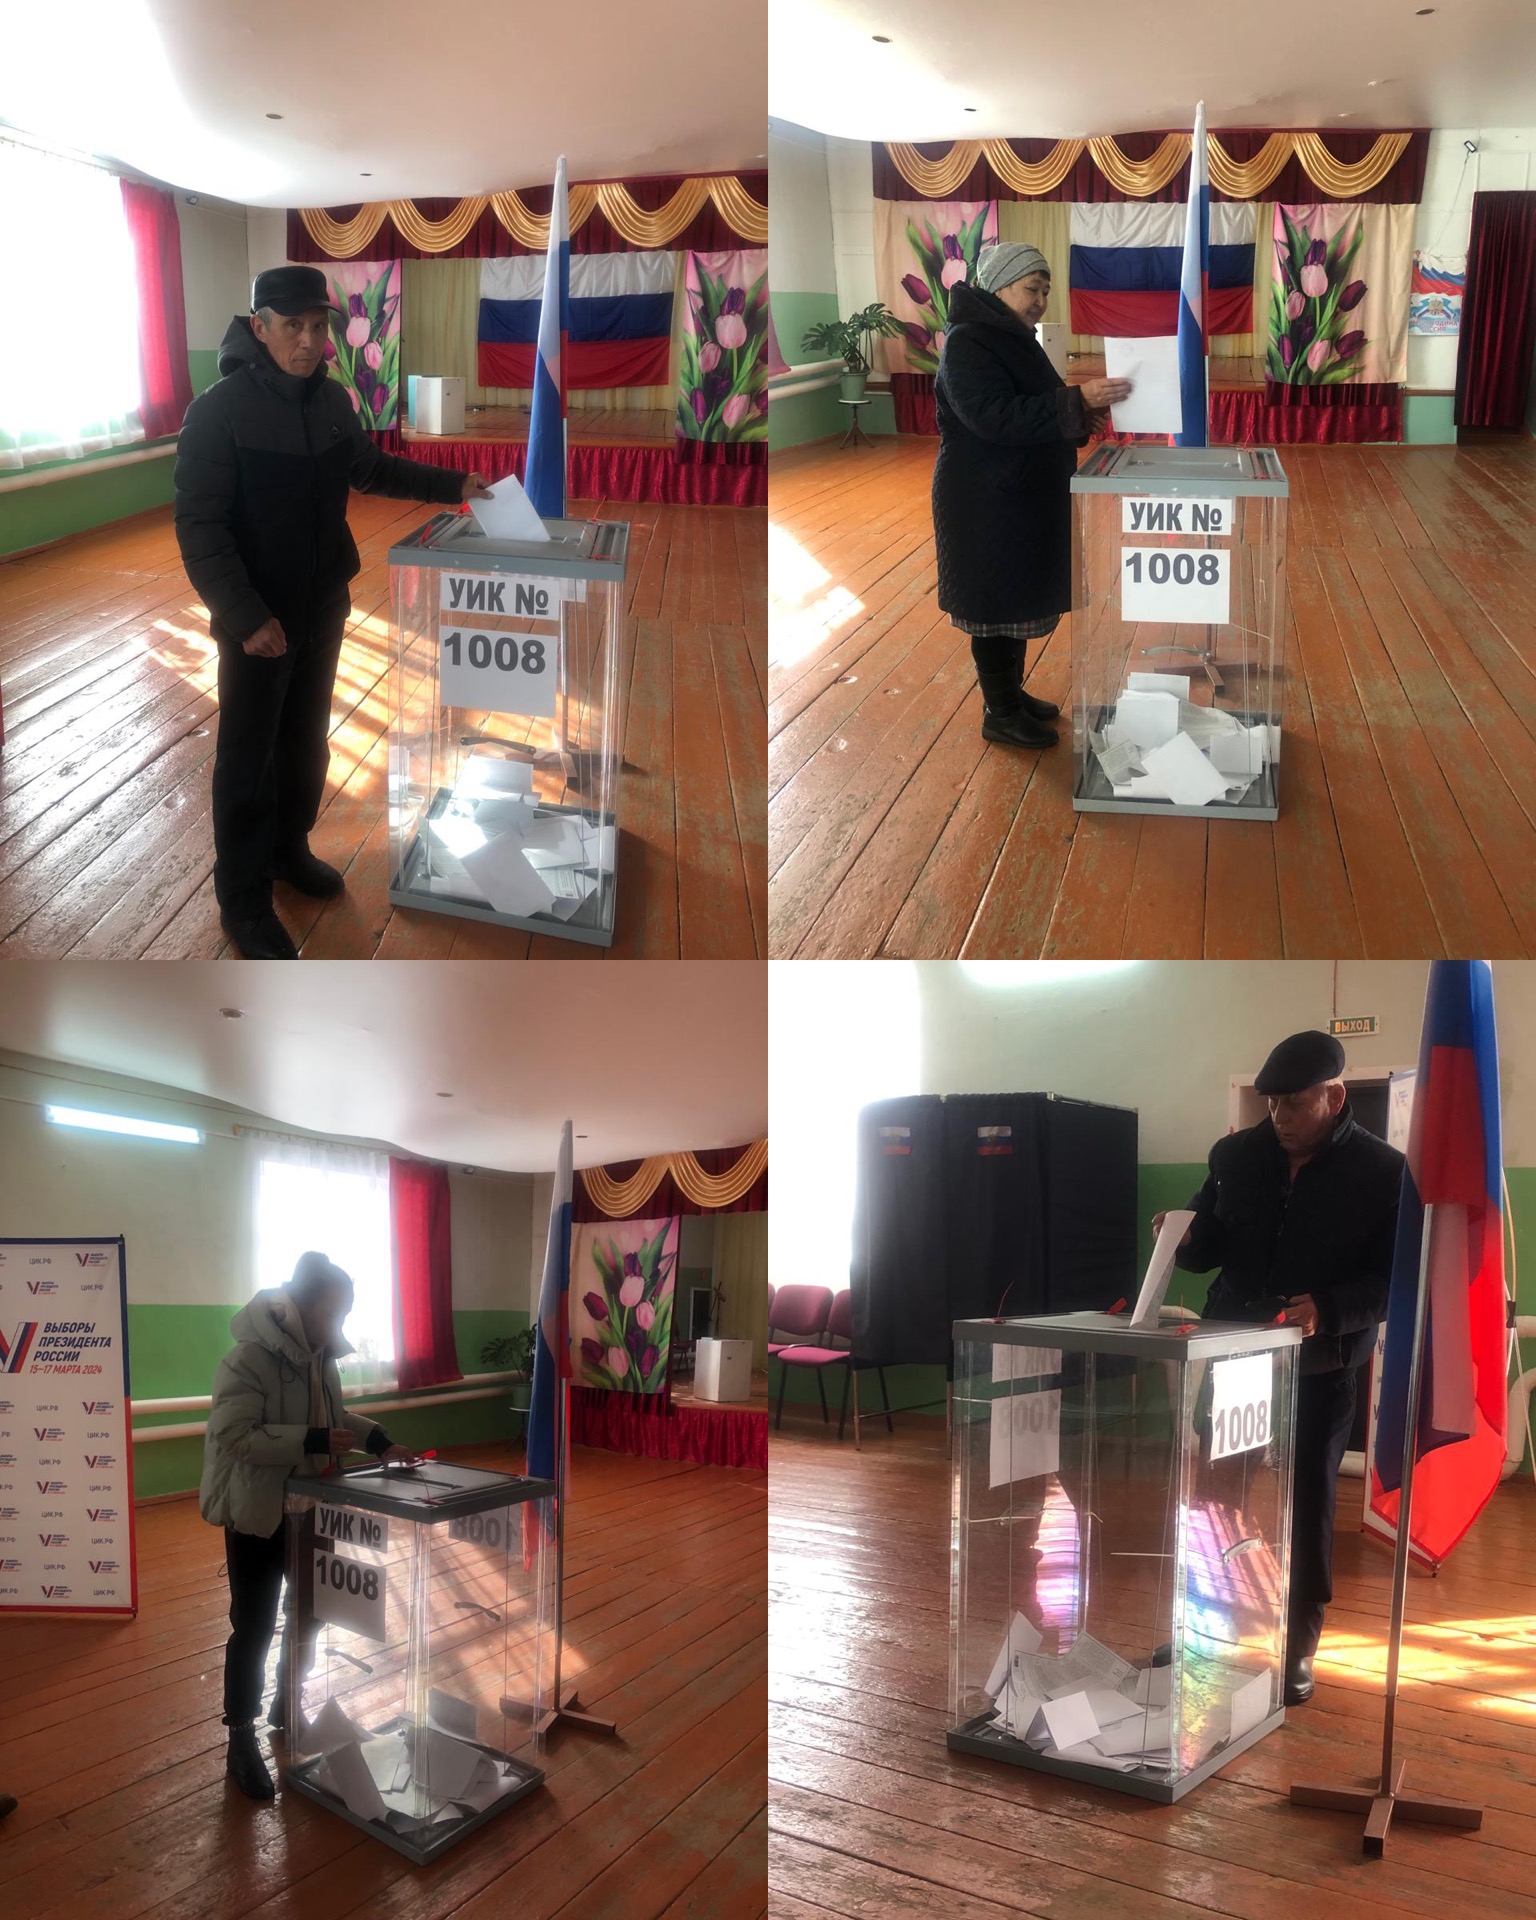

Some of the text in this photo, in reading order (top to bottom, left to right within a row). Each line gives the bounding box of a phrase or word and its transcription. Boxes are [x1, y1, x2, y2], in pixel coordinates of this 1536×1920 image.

[1130, 502, 1222, 531] УИК №
[1125, 552, 1220, 585] 1008
[449, 577, 549, 615] УИК №
[444, 632, 546, 674] 1008
[1334, 1019, 1371, 1032] ВЫХОД
[38, 1336, 112, 1349] ПРЕЗИДЕНТА
[43, 1322, 96, 1333] ВЫБОРЫ
[33, 1351, 81, 1361] РОССИИ
[53, 1365, 81, 1374] МАРТА
[82, 1365, 103, 1374] 2024
[1215, 1400, 1267, 1454] 1008
[320, 1507, 382, 1548] УИК №
[315, 1555, 379, 1600] 1008
